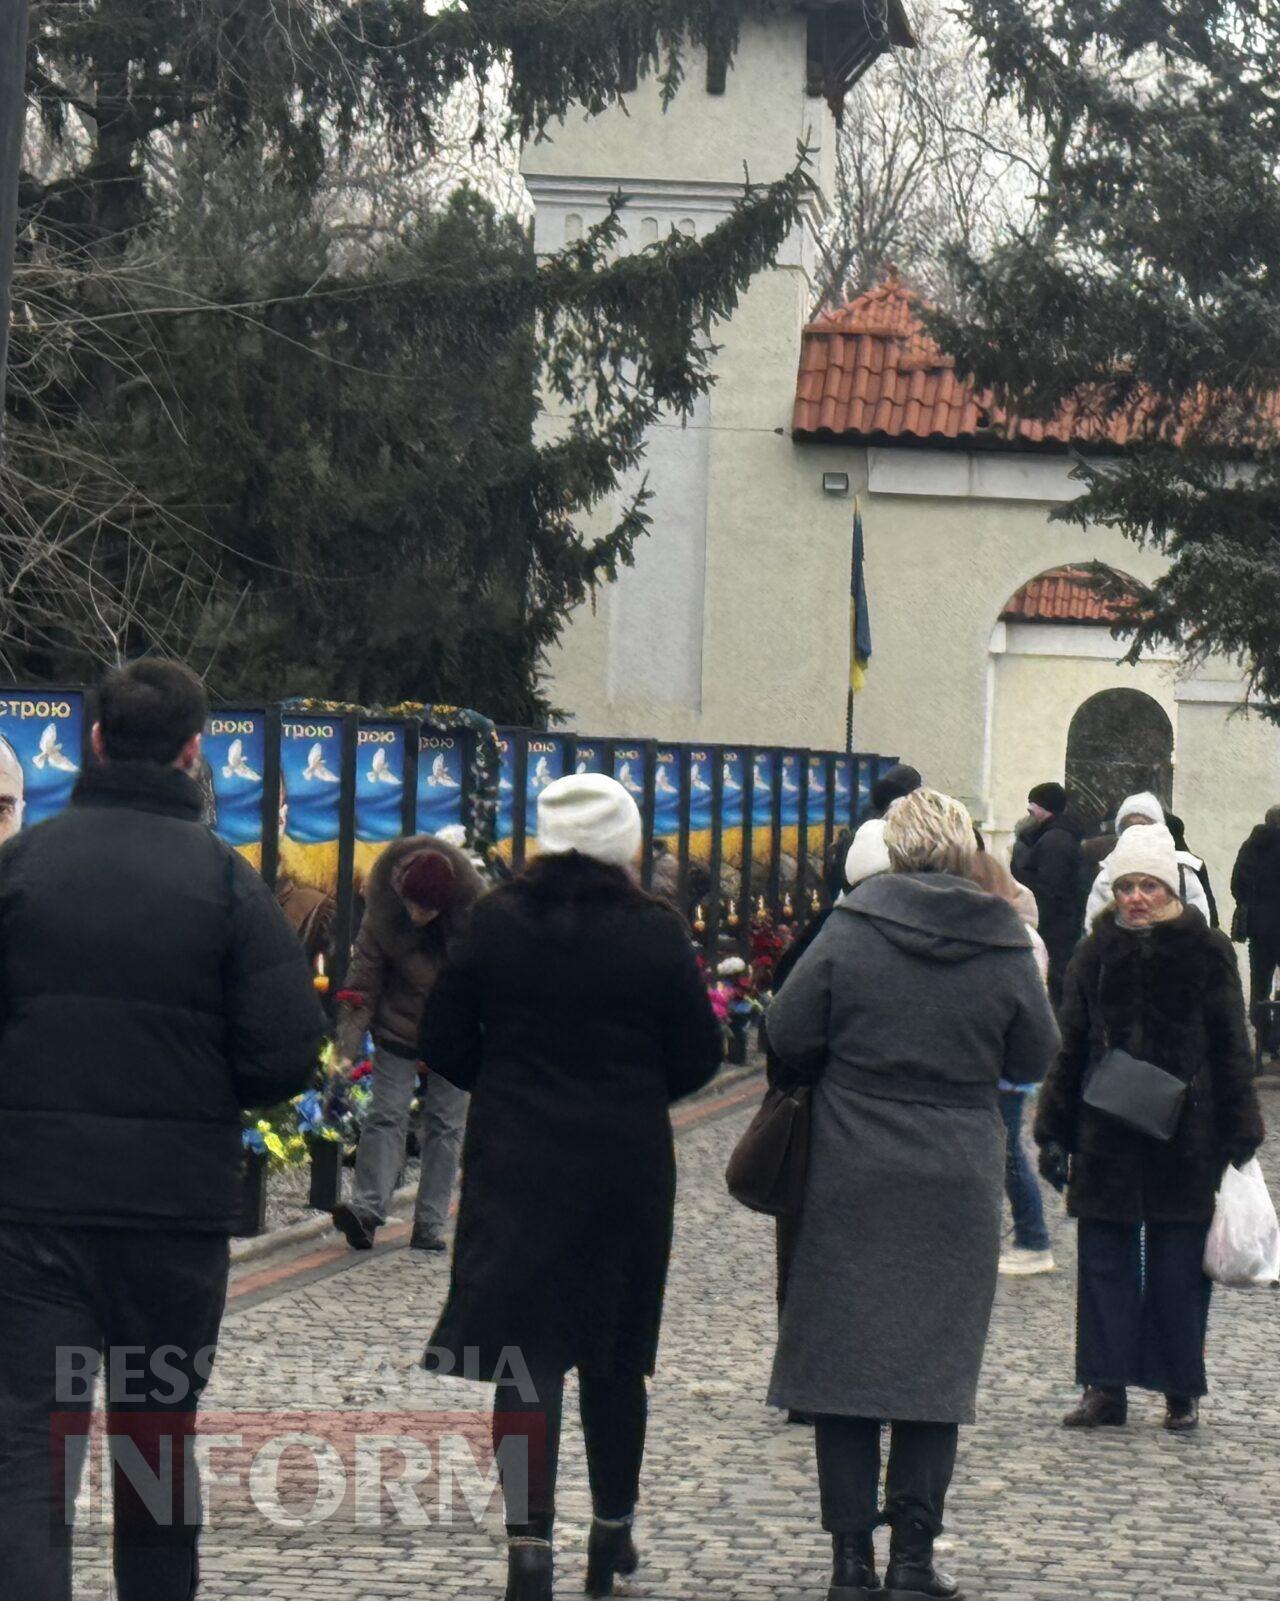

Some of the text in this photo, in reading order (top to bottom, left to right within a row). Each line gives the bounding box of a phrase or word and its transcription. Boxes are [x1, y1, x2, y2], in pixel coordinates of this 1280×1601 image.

[211, 720, 255, 736] рою
[281, 723, 334, 740] трою
[357, 730, 396, 746] рою
[418, 735, 455, 751] рою
